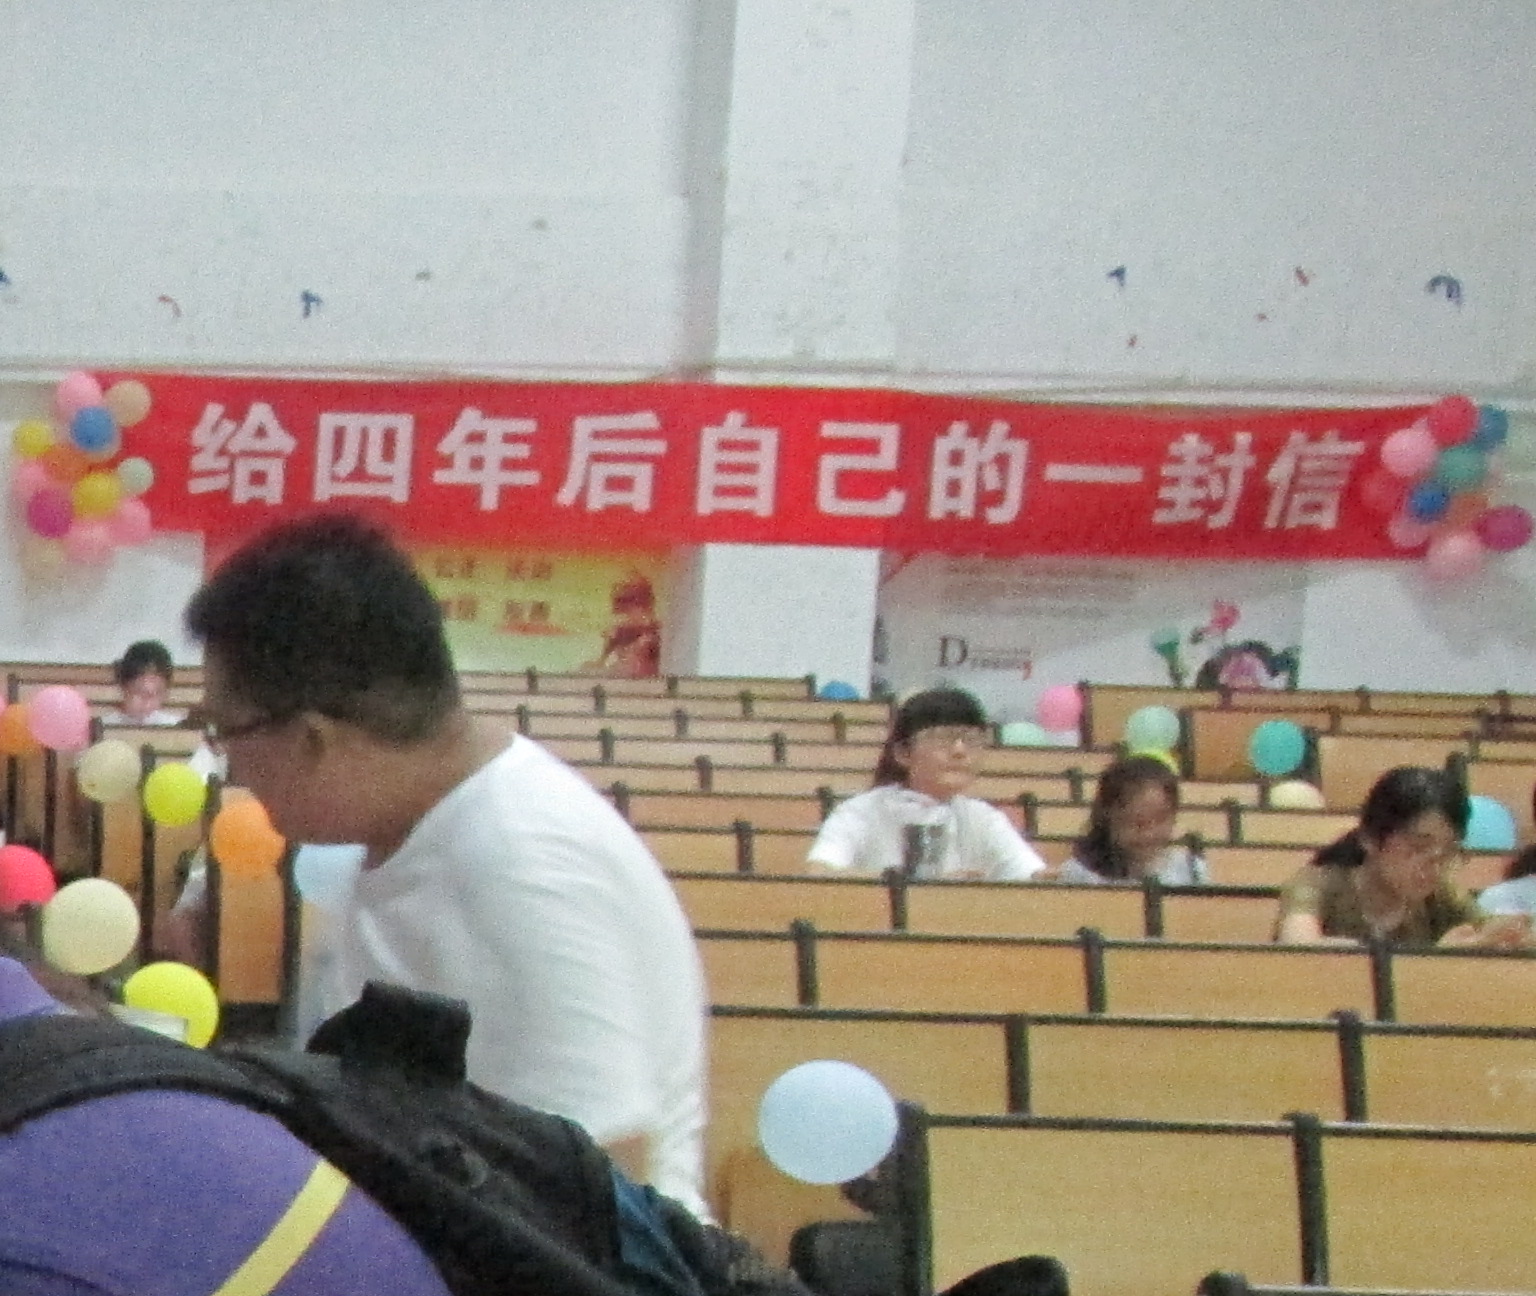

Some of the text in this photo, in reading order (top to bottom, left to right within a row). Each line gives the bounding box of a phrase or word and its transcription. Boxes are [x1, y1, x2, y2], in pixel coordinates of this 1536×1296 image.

[187, 400, 1365, 530] 给四年后自己的一封信
